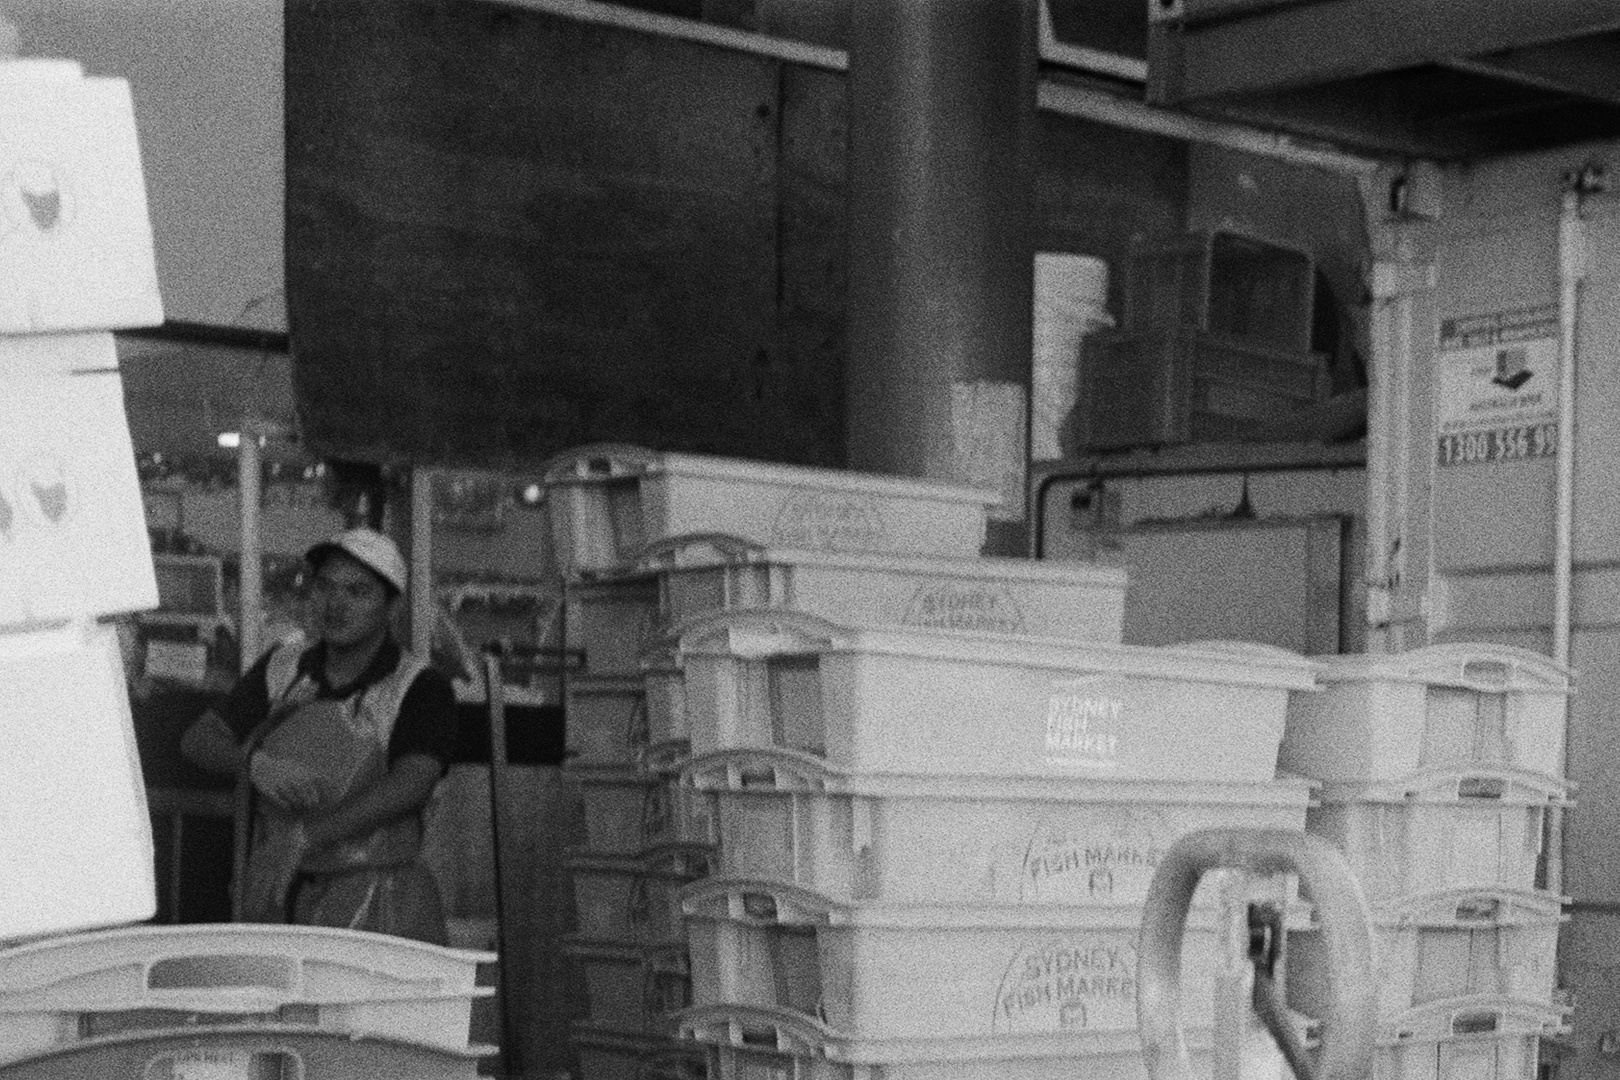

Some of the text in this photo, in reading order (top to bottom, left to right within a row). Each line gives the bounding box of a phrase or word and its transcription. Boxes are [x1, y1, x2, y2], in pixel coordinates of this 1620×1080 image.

[1444, 432, 1488, 462] 1300
[1049, 696, 1122, 718] SYDNEY
[1047, 716, 1088, 735] FISH
[1045, 733, 1118, 755] MARKET
[1085, 846, 1159, 869] MARKE
[1023, 946, 1119, 980] SYDNEY
[1003, 975, 1135, 1019] FISH MARKE
